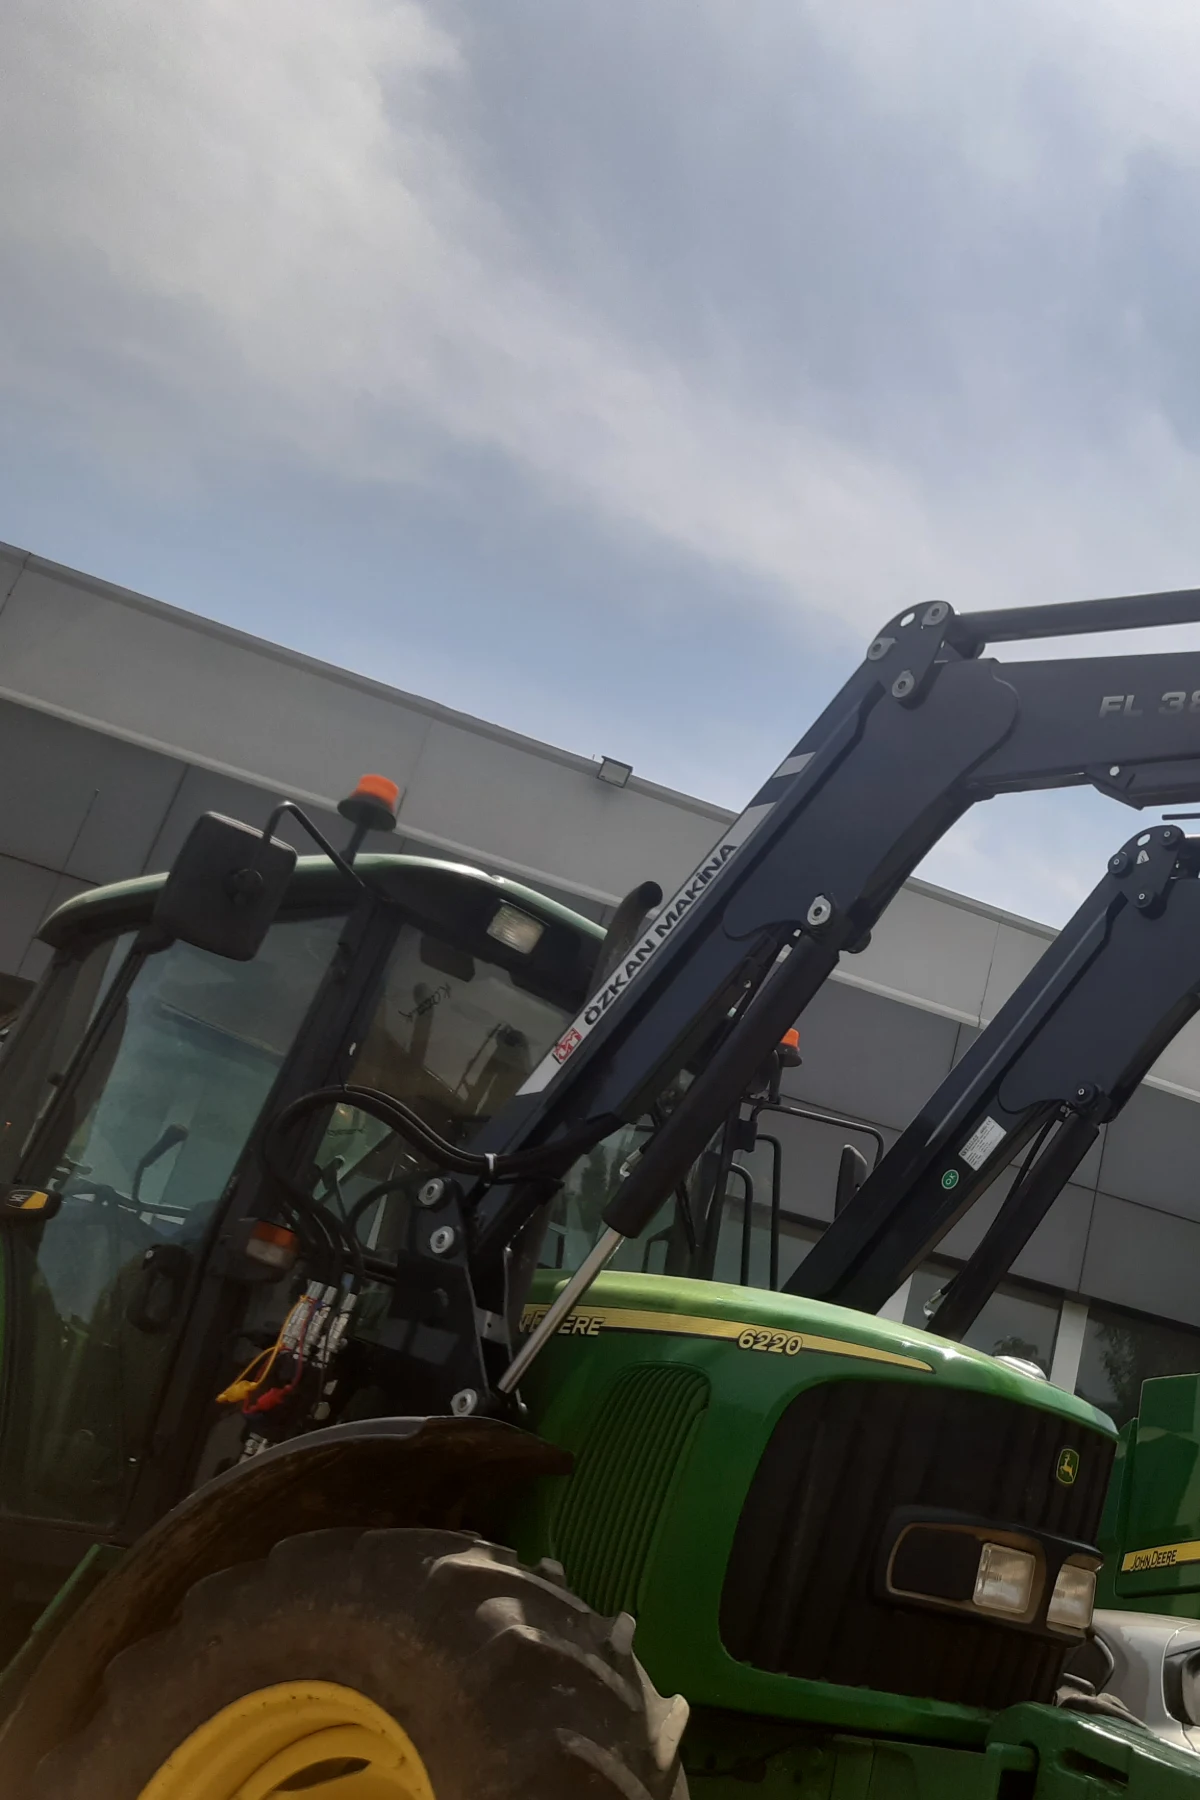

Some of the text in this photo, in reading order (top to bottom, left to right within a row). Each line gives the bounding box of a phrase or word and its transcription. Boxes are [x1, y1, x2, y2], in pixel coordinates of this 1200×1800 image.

[1099, 694, 1143, 718] FL
[584, 938, 656, 1025] ÖZKAN
[945, 1173, 957, 1186] OK
[528, 1310, 606, 1336] DERE
[738, 1328, 803, 1356] 6220
[1130, 1550, 1178, 1570] JOHN DEERE
